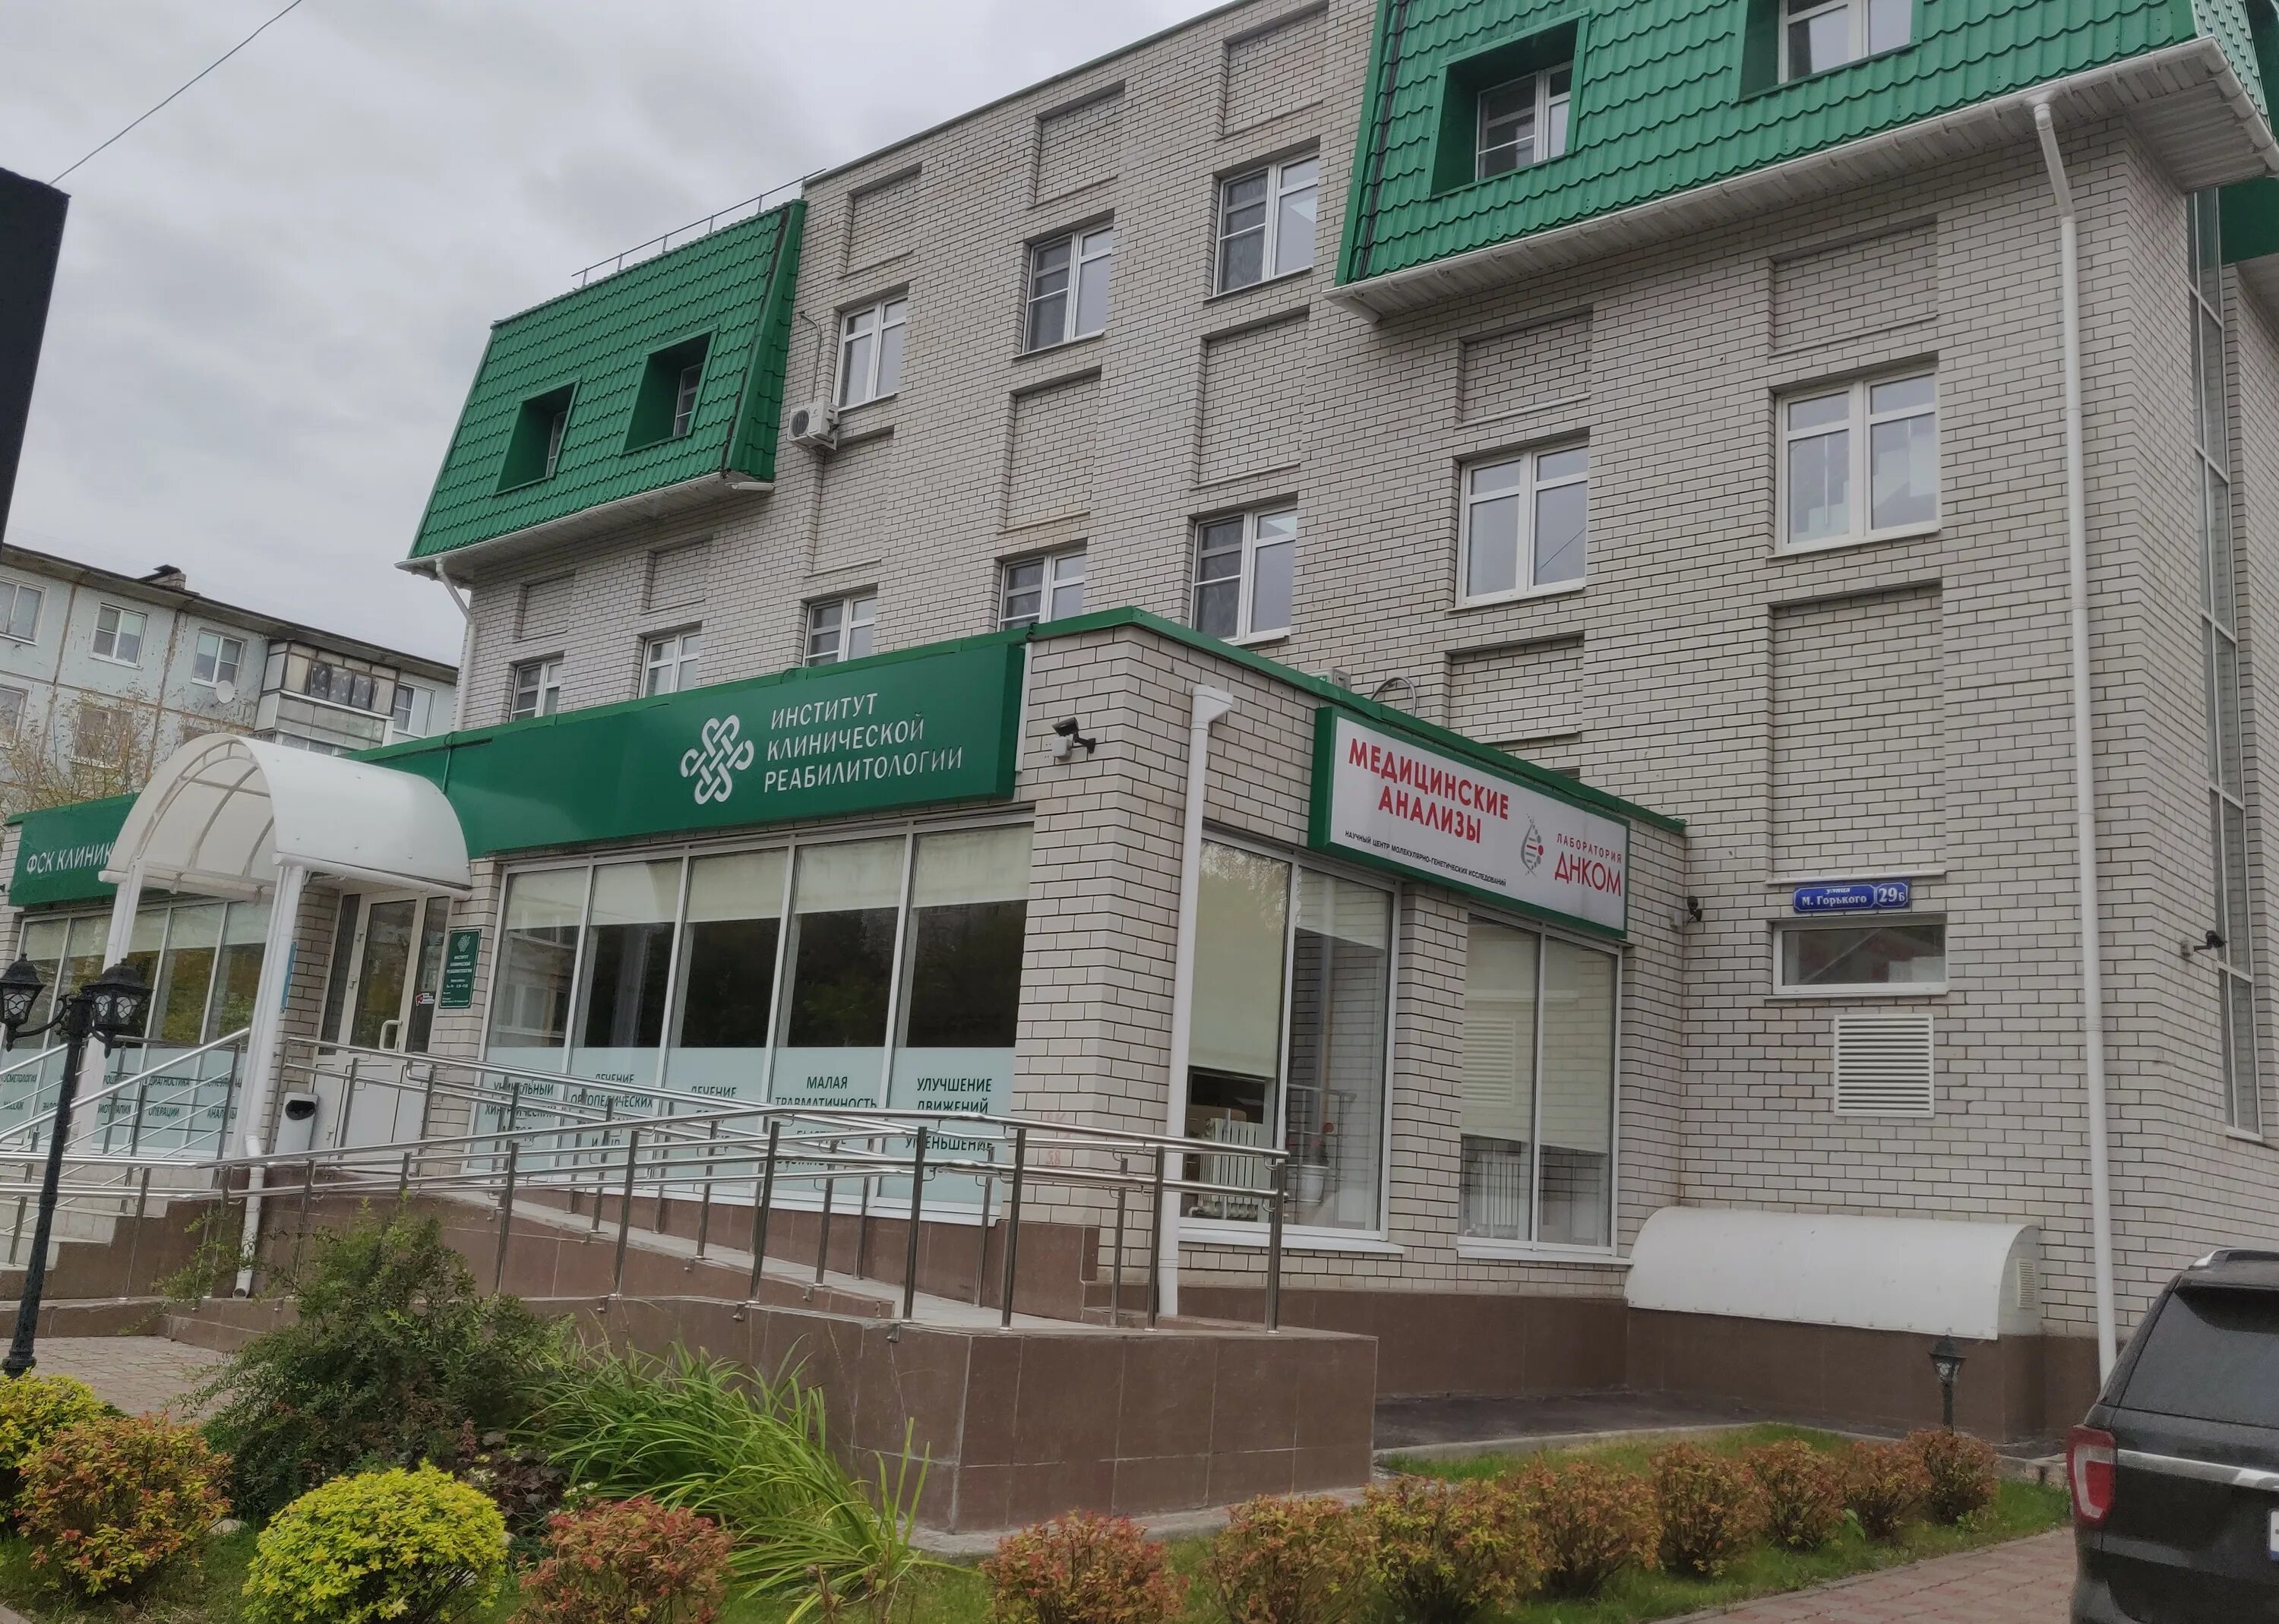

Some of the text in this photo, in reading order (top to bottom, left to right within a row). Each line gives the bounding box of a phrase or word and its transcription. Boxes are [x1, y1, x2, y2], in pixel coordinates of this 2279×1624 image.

[771, 693, 878, 730] ИНСТИТУТ
[767, 712, 925, 761] КЛИНИЧЕСКОЙ
[764, 747, 962, 792] РЕАБИЛИТОЛОГИИ
[1349, 738, 1509, 820] МЕДИЦИНСКИЕ
[1378, 785, 1481, 843] АНАЛИЗЫ
[27, 851, 55, 874] ФСК
[1345, 830, 1506, 887] НАУЧНЫЙ ЦЕНТР МОЛЕКУЛЯРНО-ГЕНЕТИЧЕСКИХ ИССЛЕДОВАНИЙ
[1557, 833, 1622, 864] ЛАБОРАТОРИЯ
[1554, 851, 1621, 897] ДНКОМ
[1802, 896, 1867, 907] М. Горького
[806, 1076, 848, 1089] МАЛАЯ
[917, 1078, 992, 1092] УЛУЧШЕНИЕ
[571, 1094, 653, 1108] ОРОПЕДИЧЕСКИХ
[906, 1136, 993, 1152] УЕНЬШЕНИЕ
